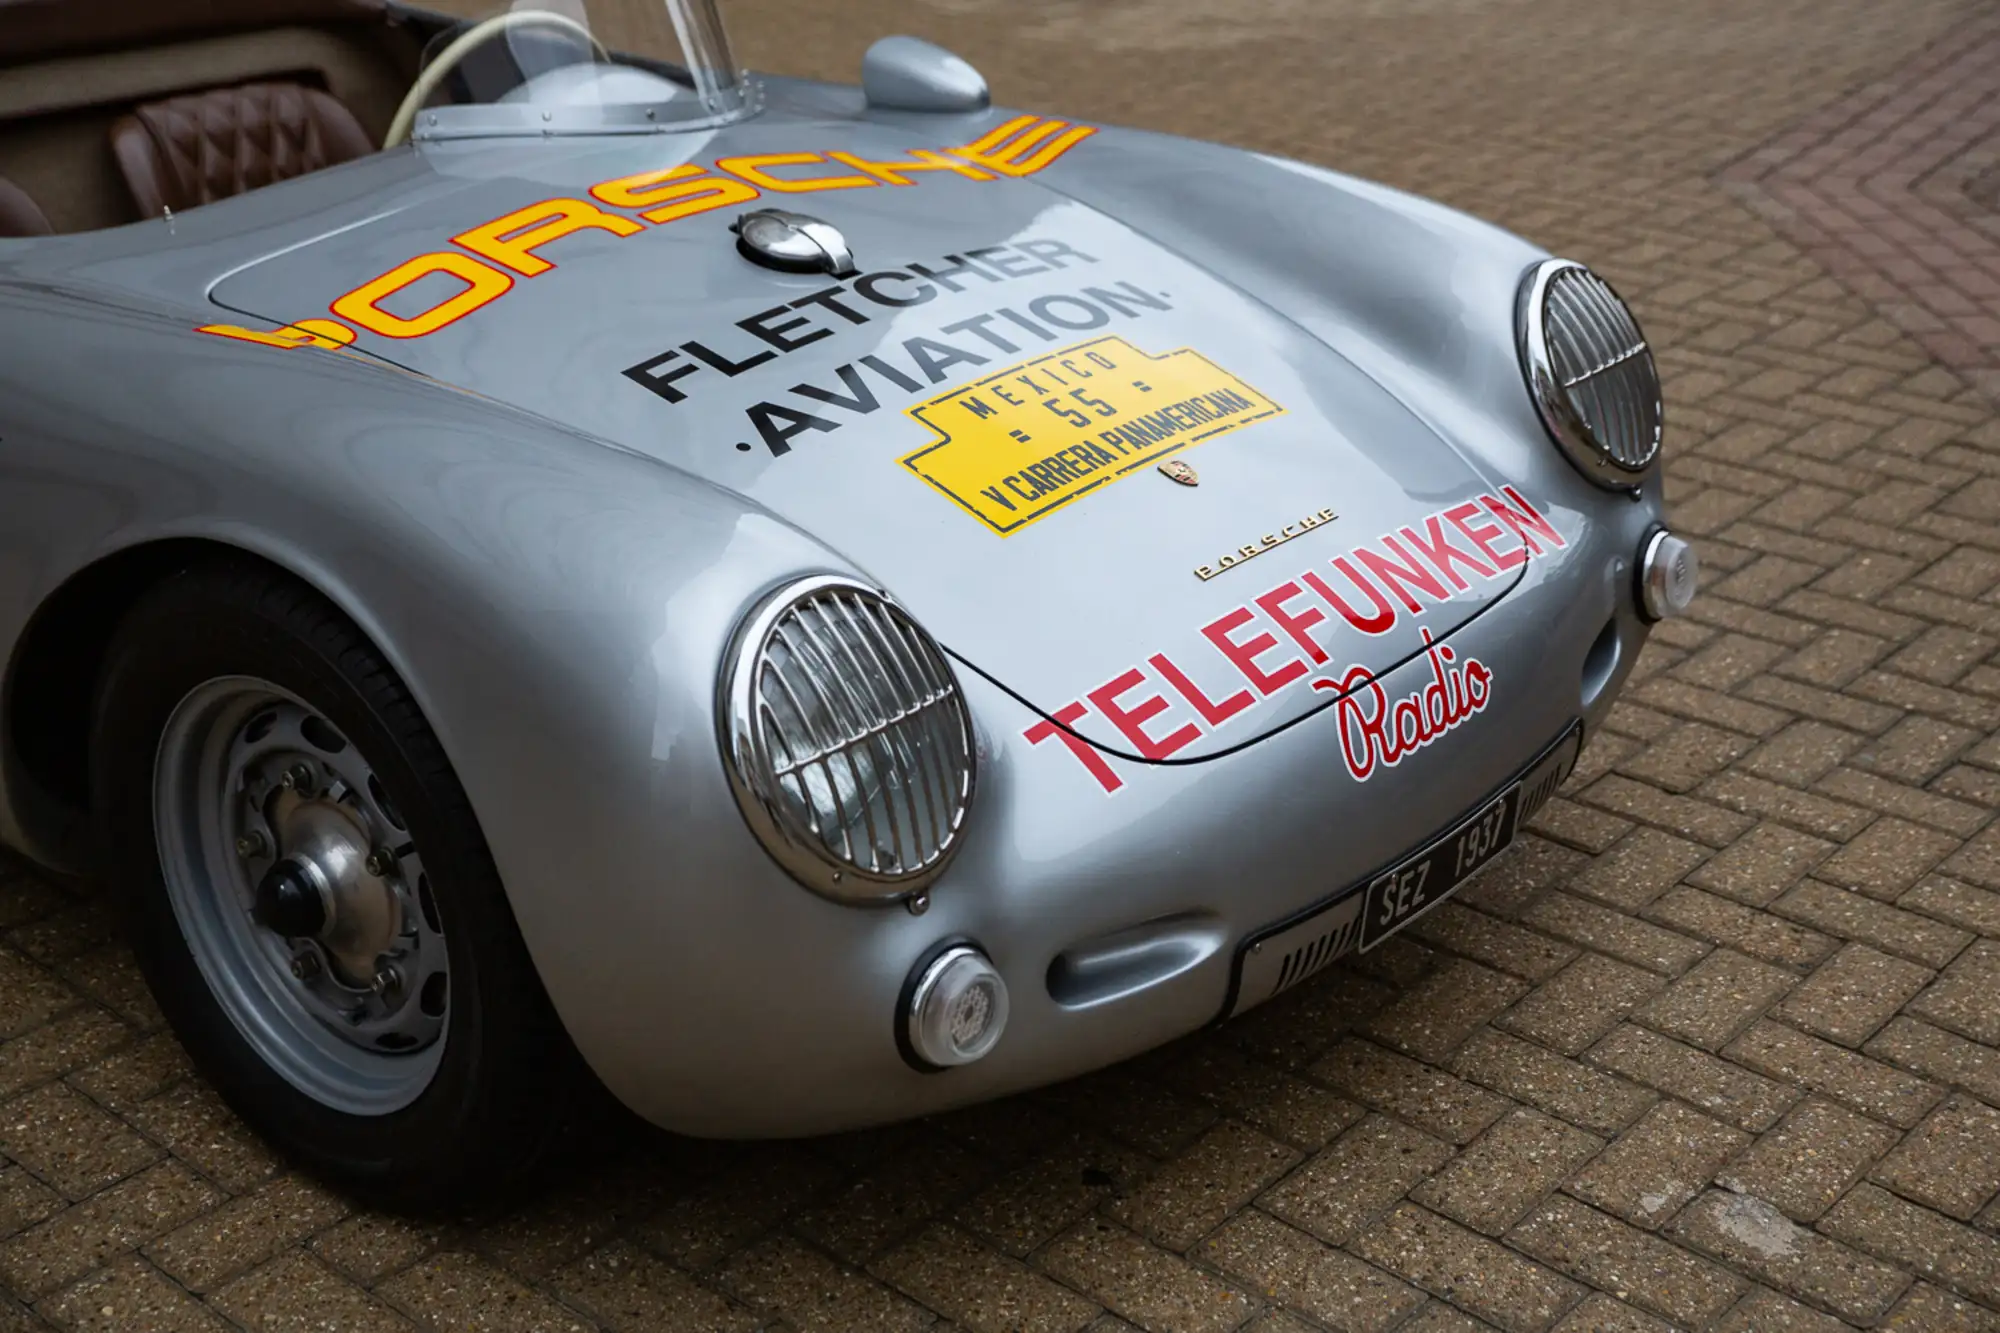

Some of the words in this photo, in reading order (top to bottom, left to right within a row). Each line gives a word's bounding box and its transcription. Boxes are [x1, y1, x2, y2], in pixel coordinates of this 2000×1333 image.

[194, 113, 1099, 350] PORSCHE
[620, 239, 1099, 403] FLETCHER
[959, 351, 1117, 419] MEXICO
[1043, 388, 1117, 428] 55
[980, 483, 1017, 511] V
[1008, 436, 1114, 500] CARRERA
[1098, 387, 1254, 454] PANAMERICANA
[1194, 508, 1339, 581] PORSCHE
[1022, 485, 1567, 794] TELEFUNKEN
[1312, 628, 1493, 782] Radio
[1380, 859, 1431, 926] SEZ
[1454, 800, 1507, 878] 1937
